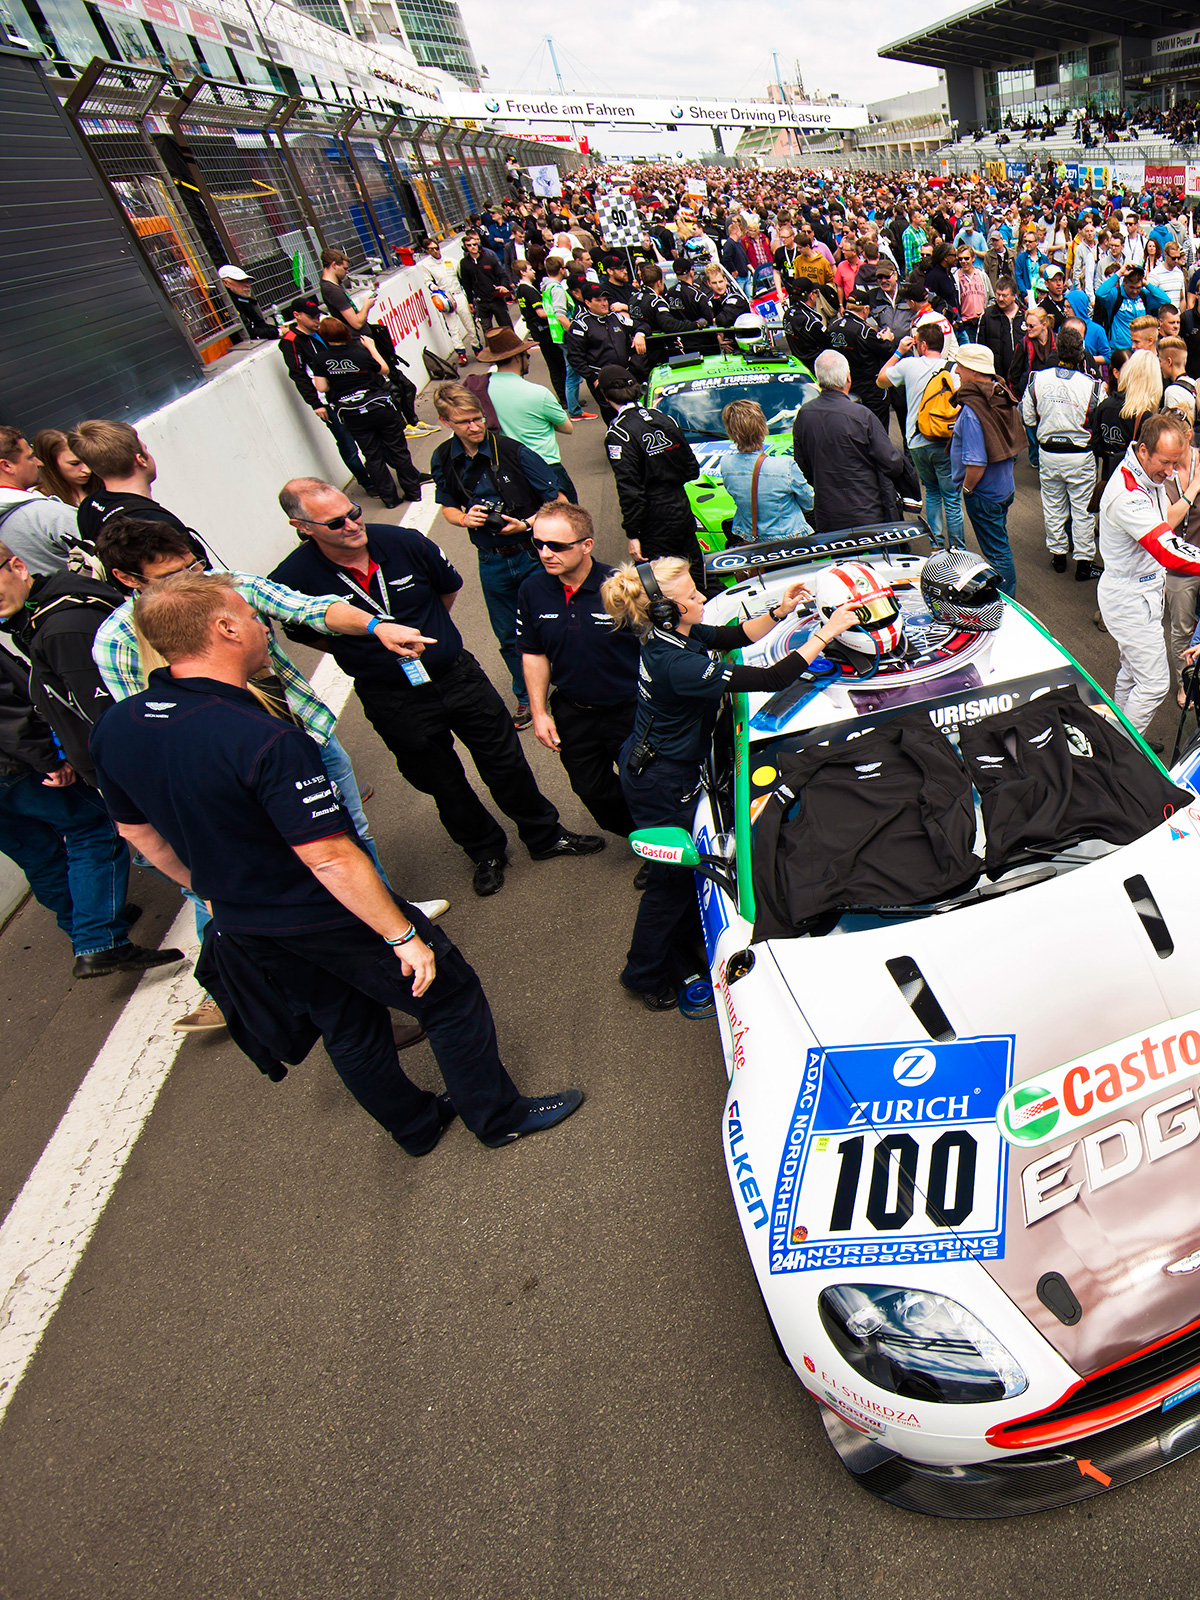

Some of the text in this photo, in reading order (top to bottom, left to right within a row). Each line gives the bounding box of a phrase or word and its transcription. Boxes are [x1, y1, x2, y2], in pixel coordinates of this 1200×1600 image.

[1157, 36, 1192, 52] BMW M Power
[506, 100, 635, 116] Freude am Fahren
[690, 106, 831, 124] Sheer Driving Pleasure
[1145, 175, 1156, 184] Audi
[1156, 176, 1162, 184] R8
[611, 209, 628, 227] 90
[801, 266, 824, 276] PACIFIC
[707, 366, 769, 375] GPSauge
[691, 374, 770, 388] GRAN TURISMO
[712, 526, 921, 570] @astonmartin
[922, 582, 942, 596] PS3
[404, 664, 421, 685] 2014
[929, 693, 1014, 728] URISMO
[641, 844, 678, 860] Castrol
[848, 1095, 970, 1126] ZURICH
[772, 1053, 820, 1251] ADAC NORDRHEIN
[728, 1100, 770, 1230] FALKEN
[829, 1130, 978, 1232] 100
[806, 1248, 999, 1268] NORDSCHLEIFE
[807, 1238, 999, 1258] NÜRBURGRING
[772, 1250, 806, 1272] 24h
[821, 1371, 919, 1424] E.I. STURDZA
[838, 1400, 882, 1428] Castrol
[853, 1400, 922, 1429] INVESTMENT FUNDS
